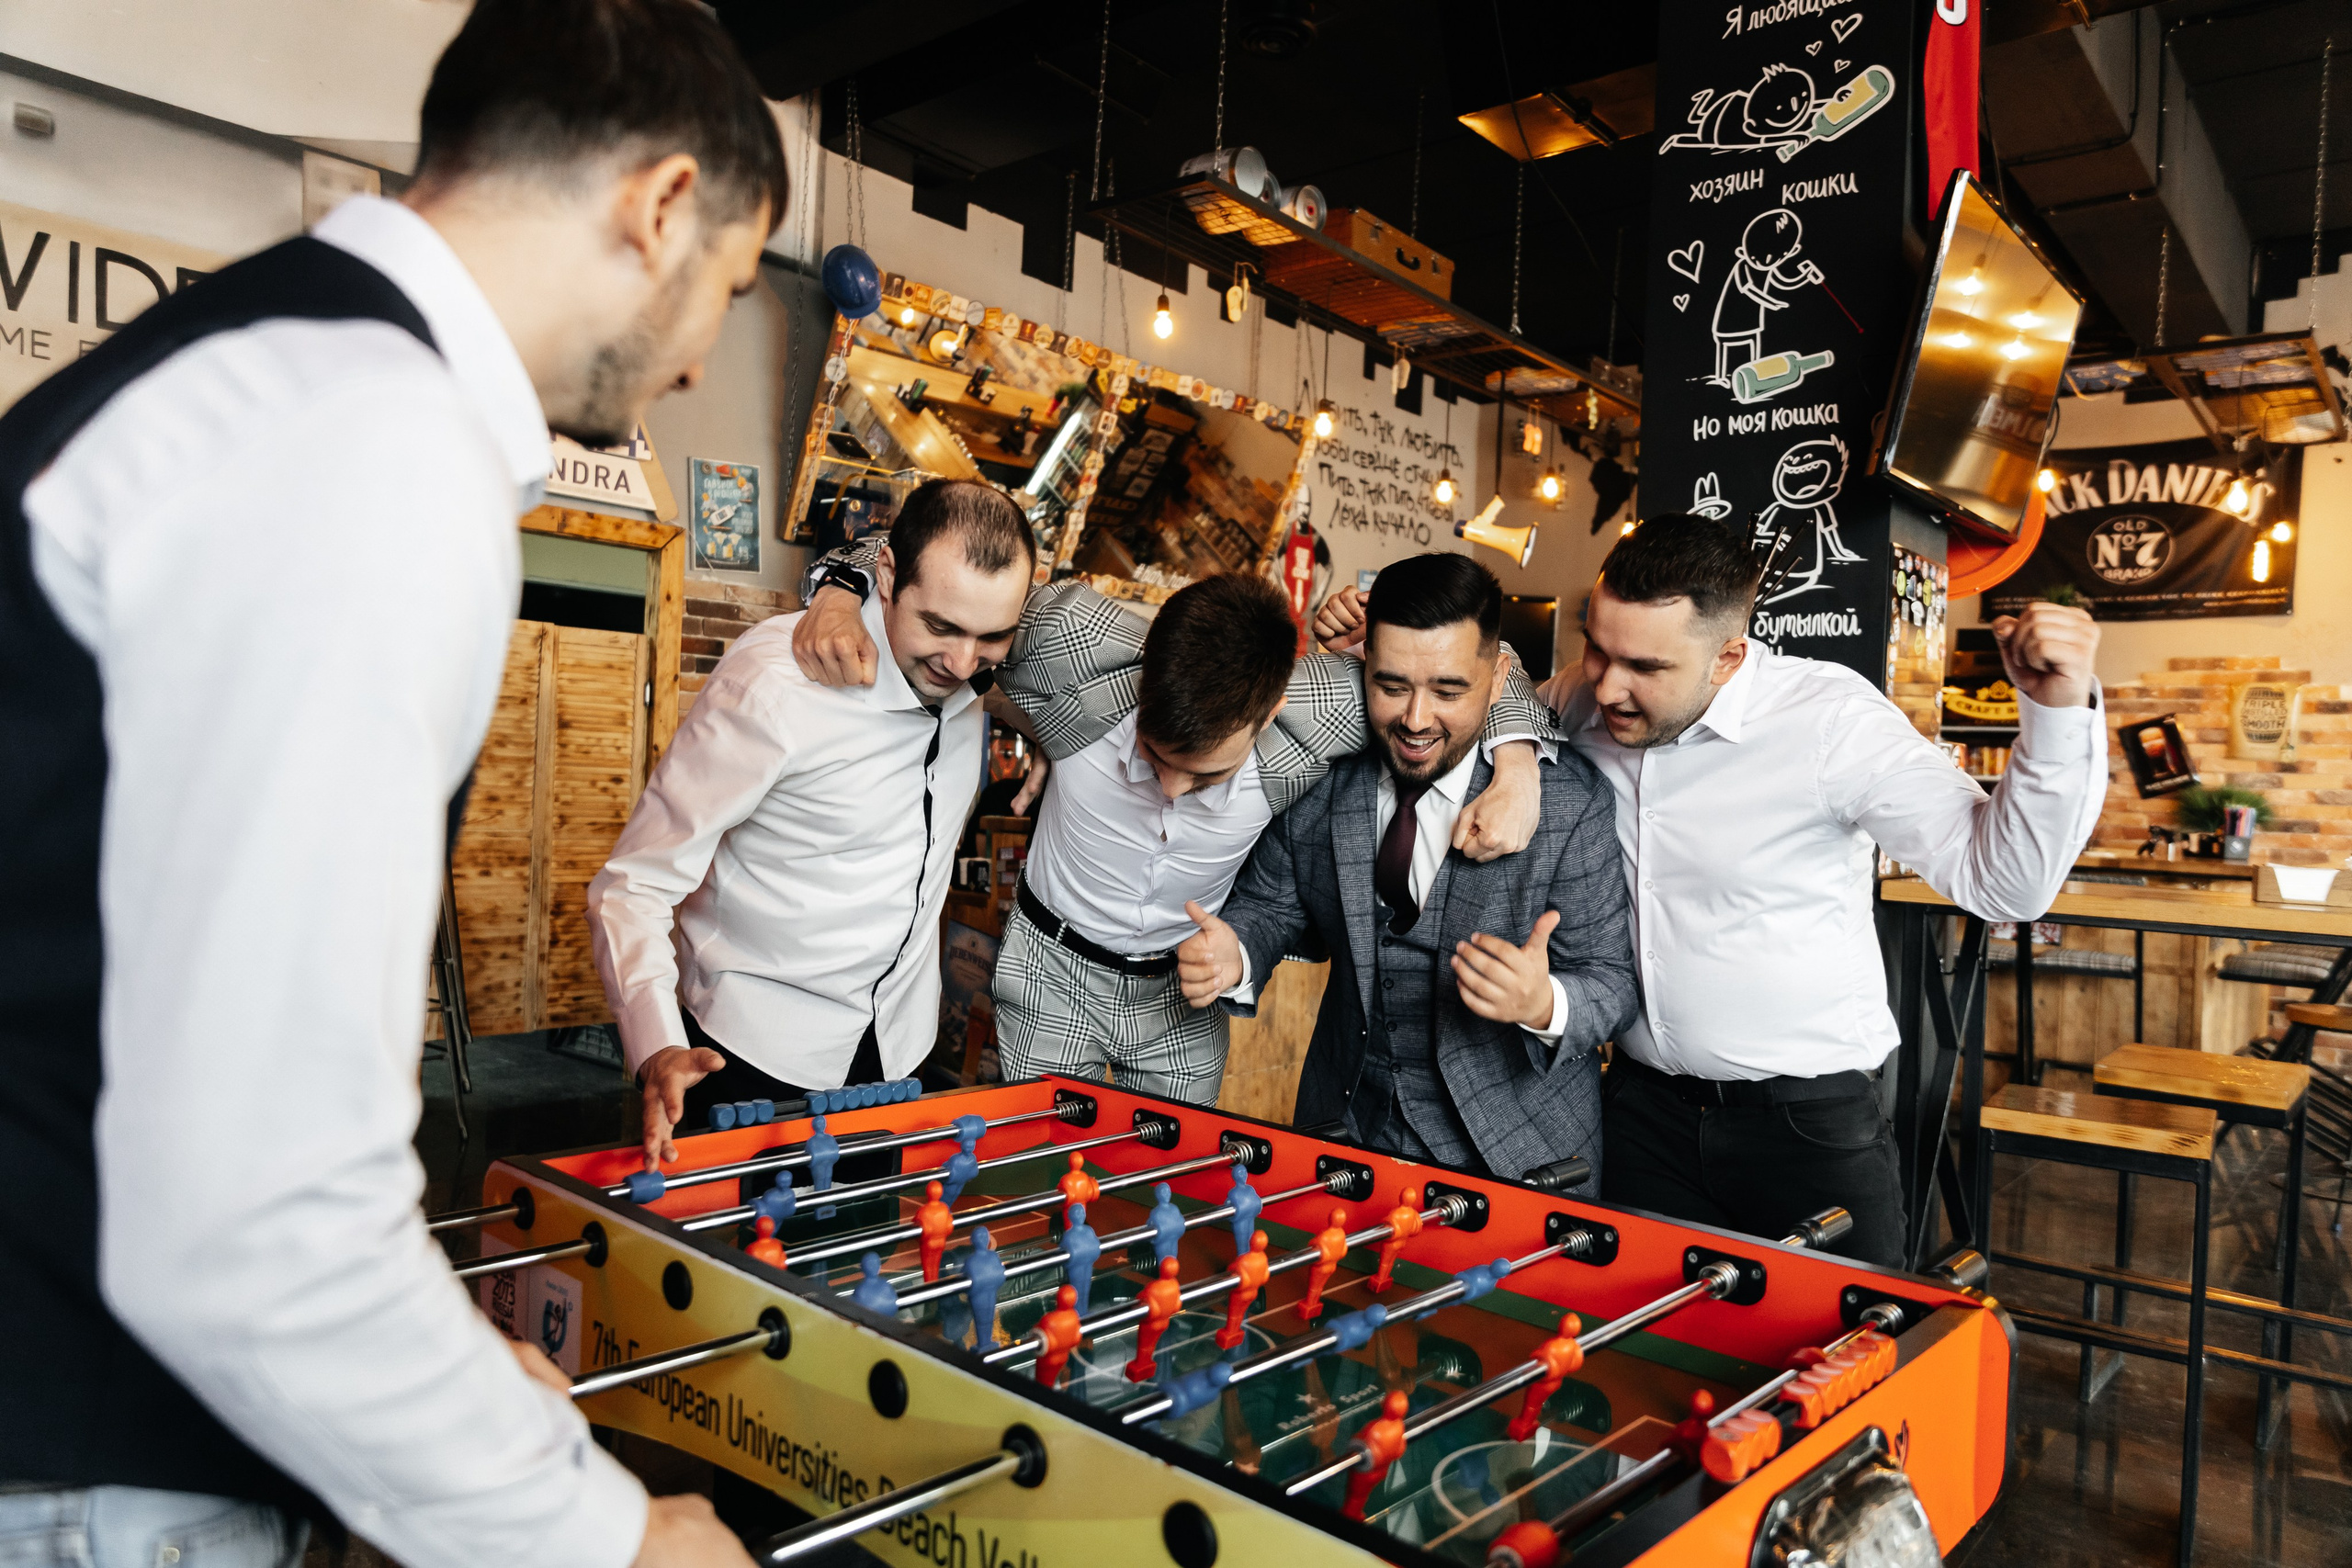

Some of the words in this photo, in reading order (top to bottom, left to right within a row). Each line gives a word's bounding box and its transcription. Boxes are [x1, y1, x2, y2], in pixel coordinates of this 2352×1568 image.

[1722, 5, 1744, 39] Я
[1747, 0, 1853, 31] любящ
[1689, 168, 1764, 204] хозяин
[1781, 172, 1860, 206] кошки
[0, 219, 218, 333] VID
[2108, 458, 2277, 527] DANIE'S
[2112, 519, 2149, 533] OLD
[1754, 607, 1862, 645] бутылкой
[2244, 699, 2287, 709] TRIPLE
[2240, 719, 2286, 729] SMOOTH
[593, 1319, 622, 1367] 7th
[728, 1393, 869, 1509] Universities
